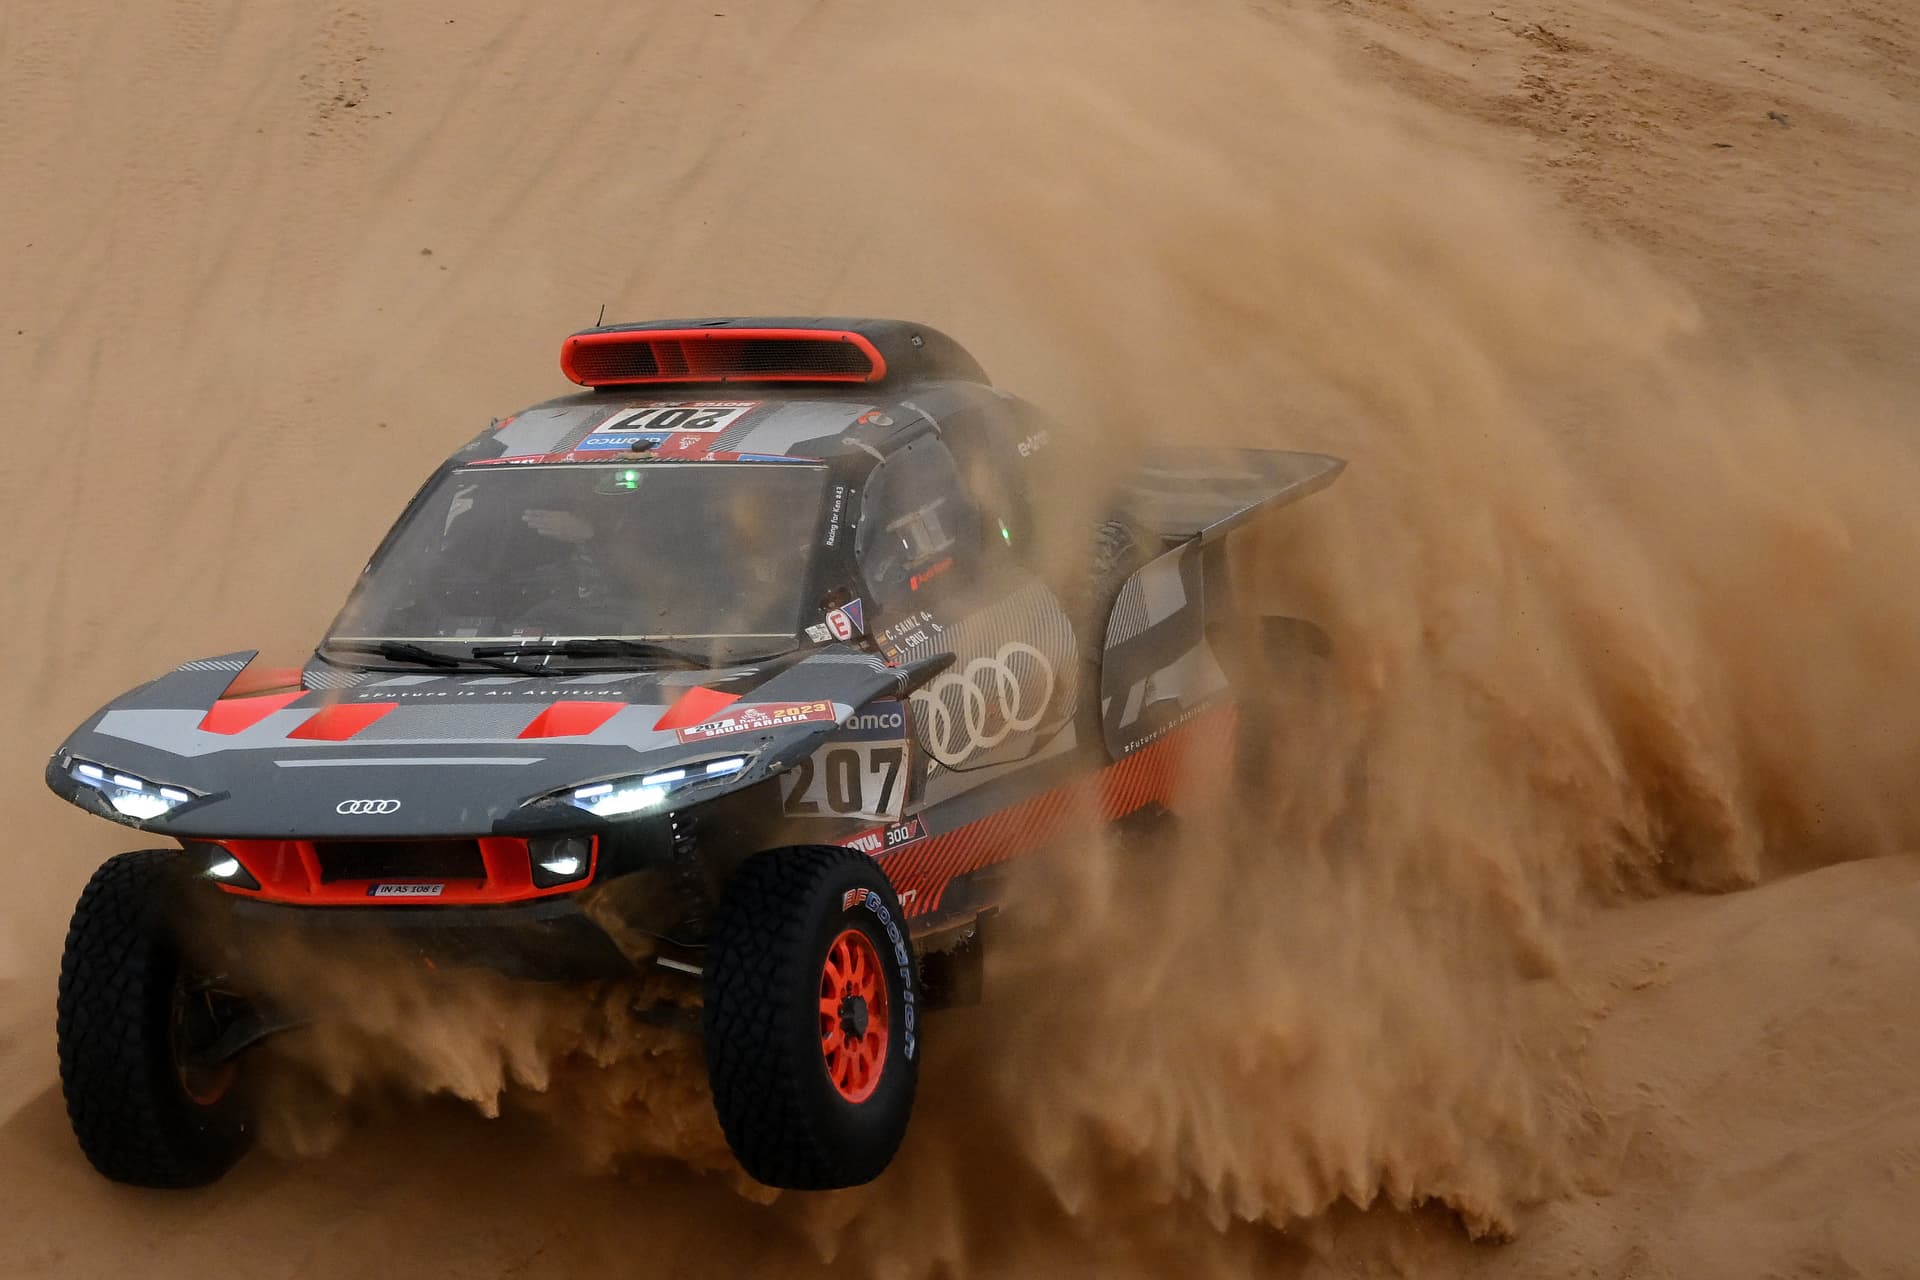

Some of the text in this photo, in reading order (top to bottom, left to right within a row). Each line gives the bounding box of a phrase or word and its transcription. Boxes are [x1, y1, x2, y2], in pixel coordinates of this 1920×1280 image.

[608, 408, 737, 430] 207
[832, 500, 841, 512] Ken
[831, 513, 839, 523] for
[826, 524, 839, 546] Racing
[831, 613, 849, 637] E
[895, 615, 920, 635] SAINZ
[905, 630, 928, 647] CRUZ
[773, 703, 827, 718] 2023
[705, 713, 808, 737] SAUDI ARABIA
[845, 713, 902, 730] amco
[783, 747, 903, 816] 207
[841, 833, 880, 853] OTUL
[380, 885, 441, 893] IN AS 108 E
